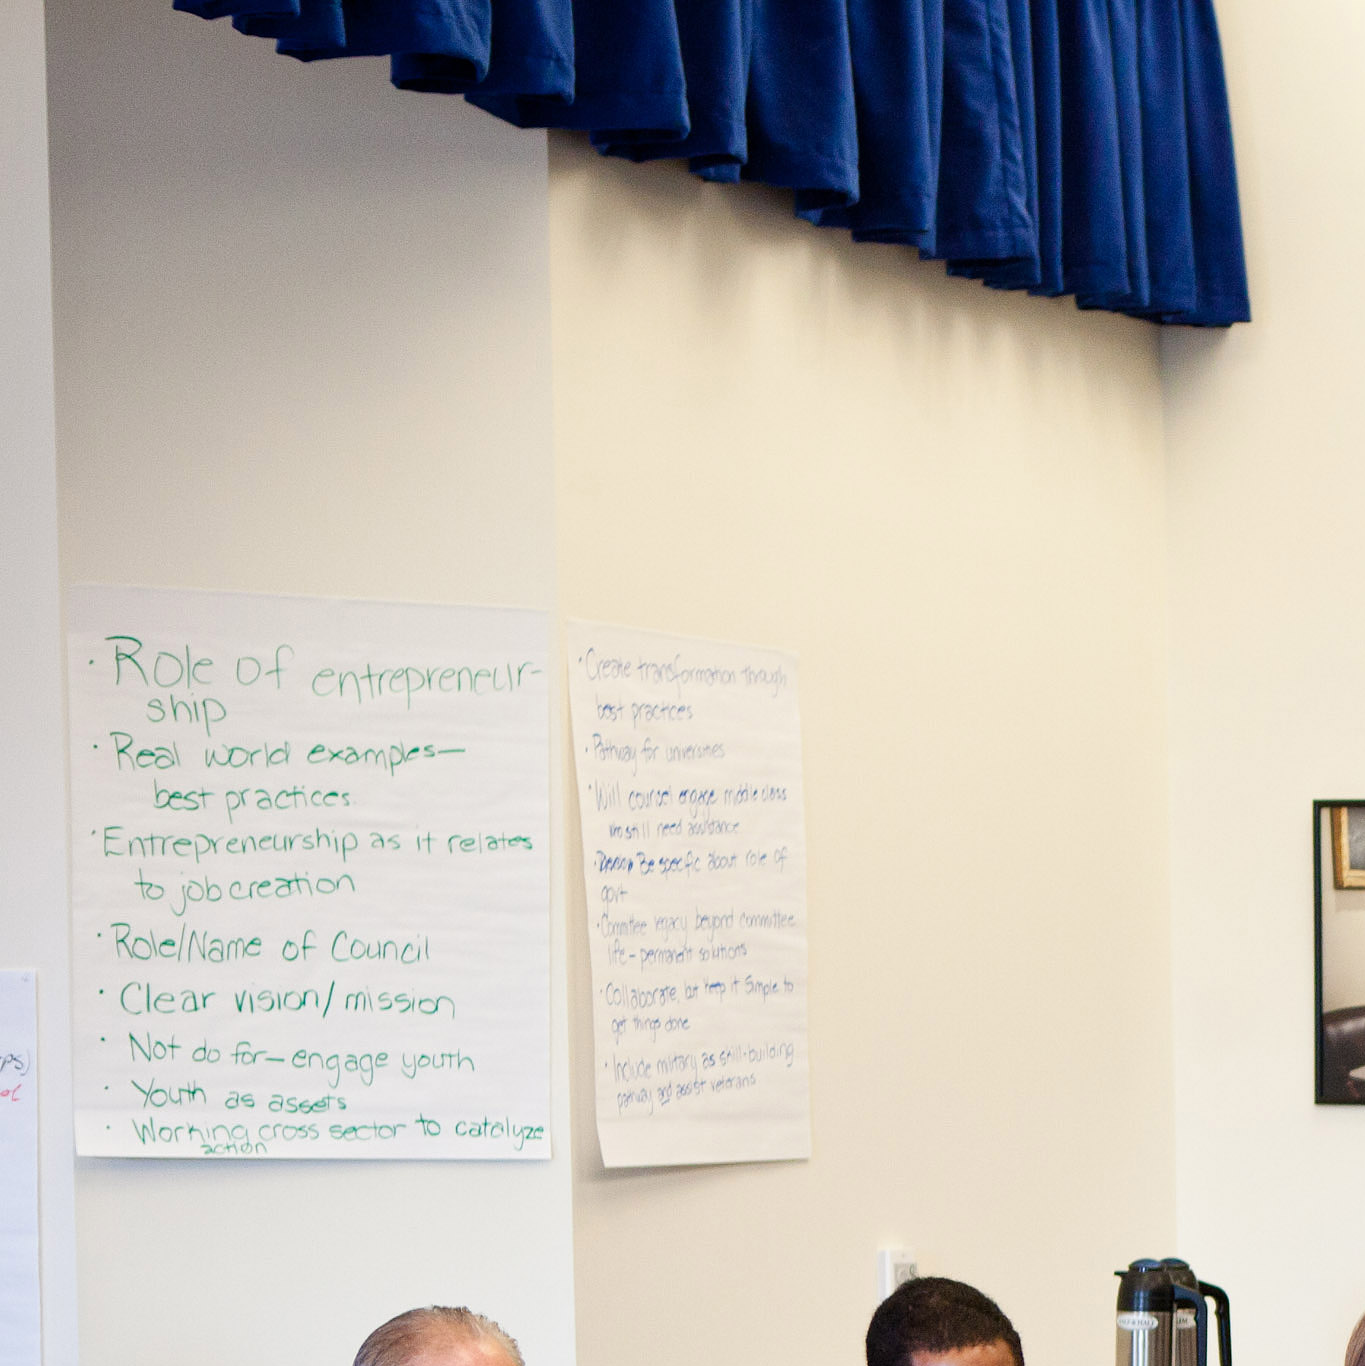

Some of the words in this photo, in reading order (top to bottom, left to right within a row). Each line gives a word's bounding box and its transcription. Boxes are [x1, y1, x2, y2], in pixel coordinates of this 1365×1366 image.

[105, 636, 213, 688] Role
[236, 645, 295, 689] of
[312, 660, 543, 709] entrepreneur-
[147, 693, 227, 736] ship
[595, 694, 625, 722] best
[109, 731, 181, 770] Real
[205, 741, 290, 768] world
[153, 778, 214, 812] best
[226, 784, 351, 823] practices
[103, 826, 359, 863] Entrepreneurship
[370, 832, 401, 851] as
[416, 830, 433, 853] it
[447, 829, 534, 854] relates
[134, 868, 165, 901] to
[170, 873, 222, 916] job
[229, 873, 356, 901] creation
[110, 922, 262, 965] Role/Name
[282, 930, 316, 961] of
[331, 930, 430, 964] Council
[120, 981, 216, 1015] Clear
[665, 1016, 691, 1034] done
[129, 1032, 182, 1063] Not
[192, 1033, 222, 1064] do
[401, 1047, 475, 1080] youth
[613, 1053, 652, 1083] Include
[131, 1079, 207, 1110] Youth
[224, 1090, 255, 1110] as
[267, 1092, 348, 1115] assets
[710, 1072, 757, 1092] veterans
[131, 1117, 249, 1147] Working
[258, 1122, 319, 1142] cross
[329, 1117, 406, 1140] sector
[415, 1113, 441, 1137] to
[455, 1114, 546, 1151] catalyze
[199, 1139, 269, 1156] action
